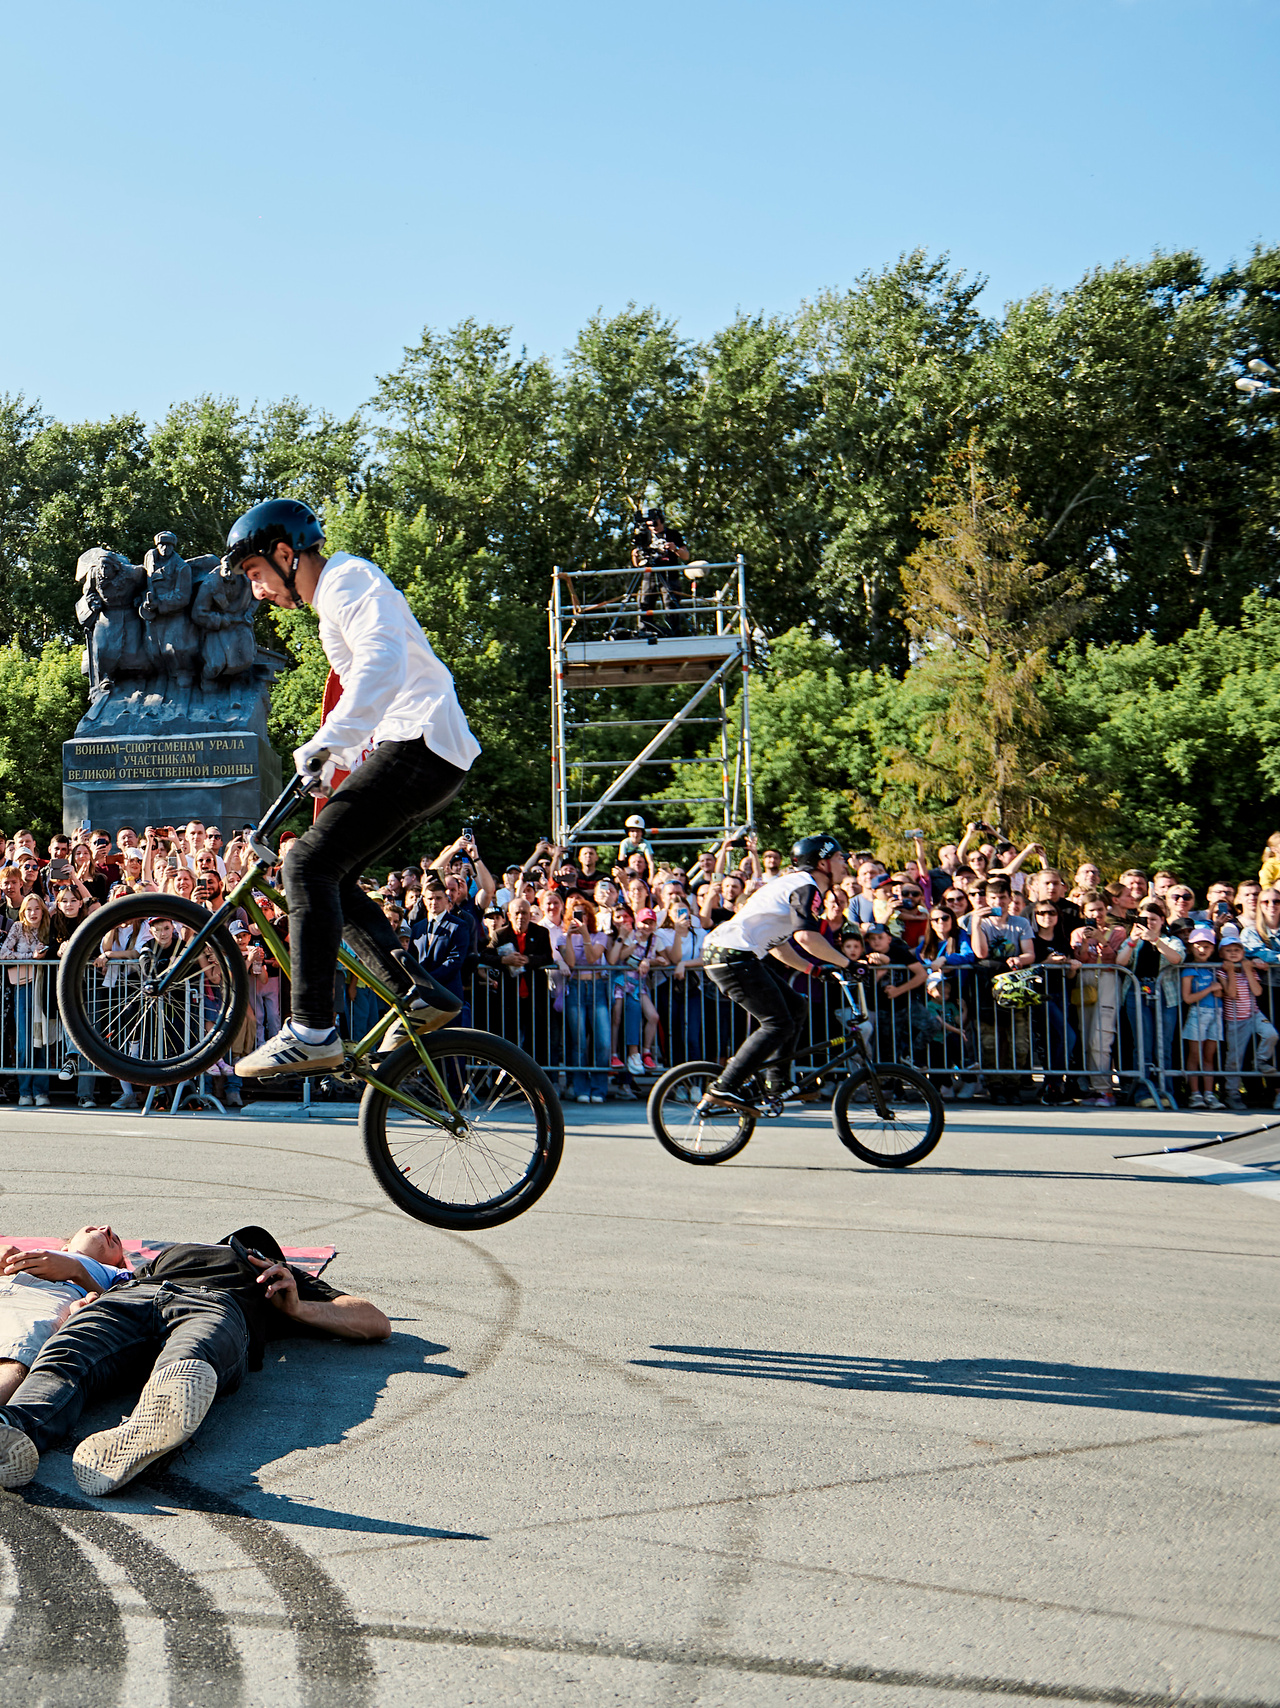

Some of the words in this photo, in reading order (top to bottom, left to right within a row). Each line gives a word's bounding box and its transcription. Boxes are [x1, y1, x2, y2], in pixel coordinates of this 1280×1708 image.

[209, 739, 245, 750] УРАЛА
[123, 754, 196, 766] УЧАСТНИКАМ
[68, 767, 116, 780] ВЕЛИКОЙ
[119, 764, 209, 779] ОТЕЧЕСТВЕННОЙ
